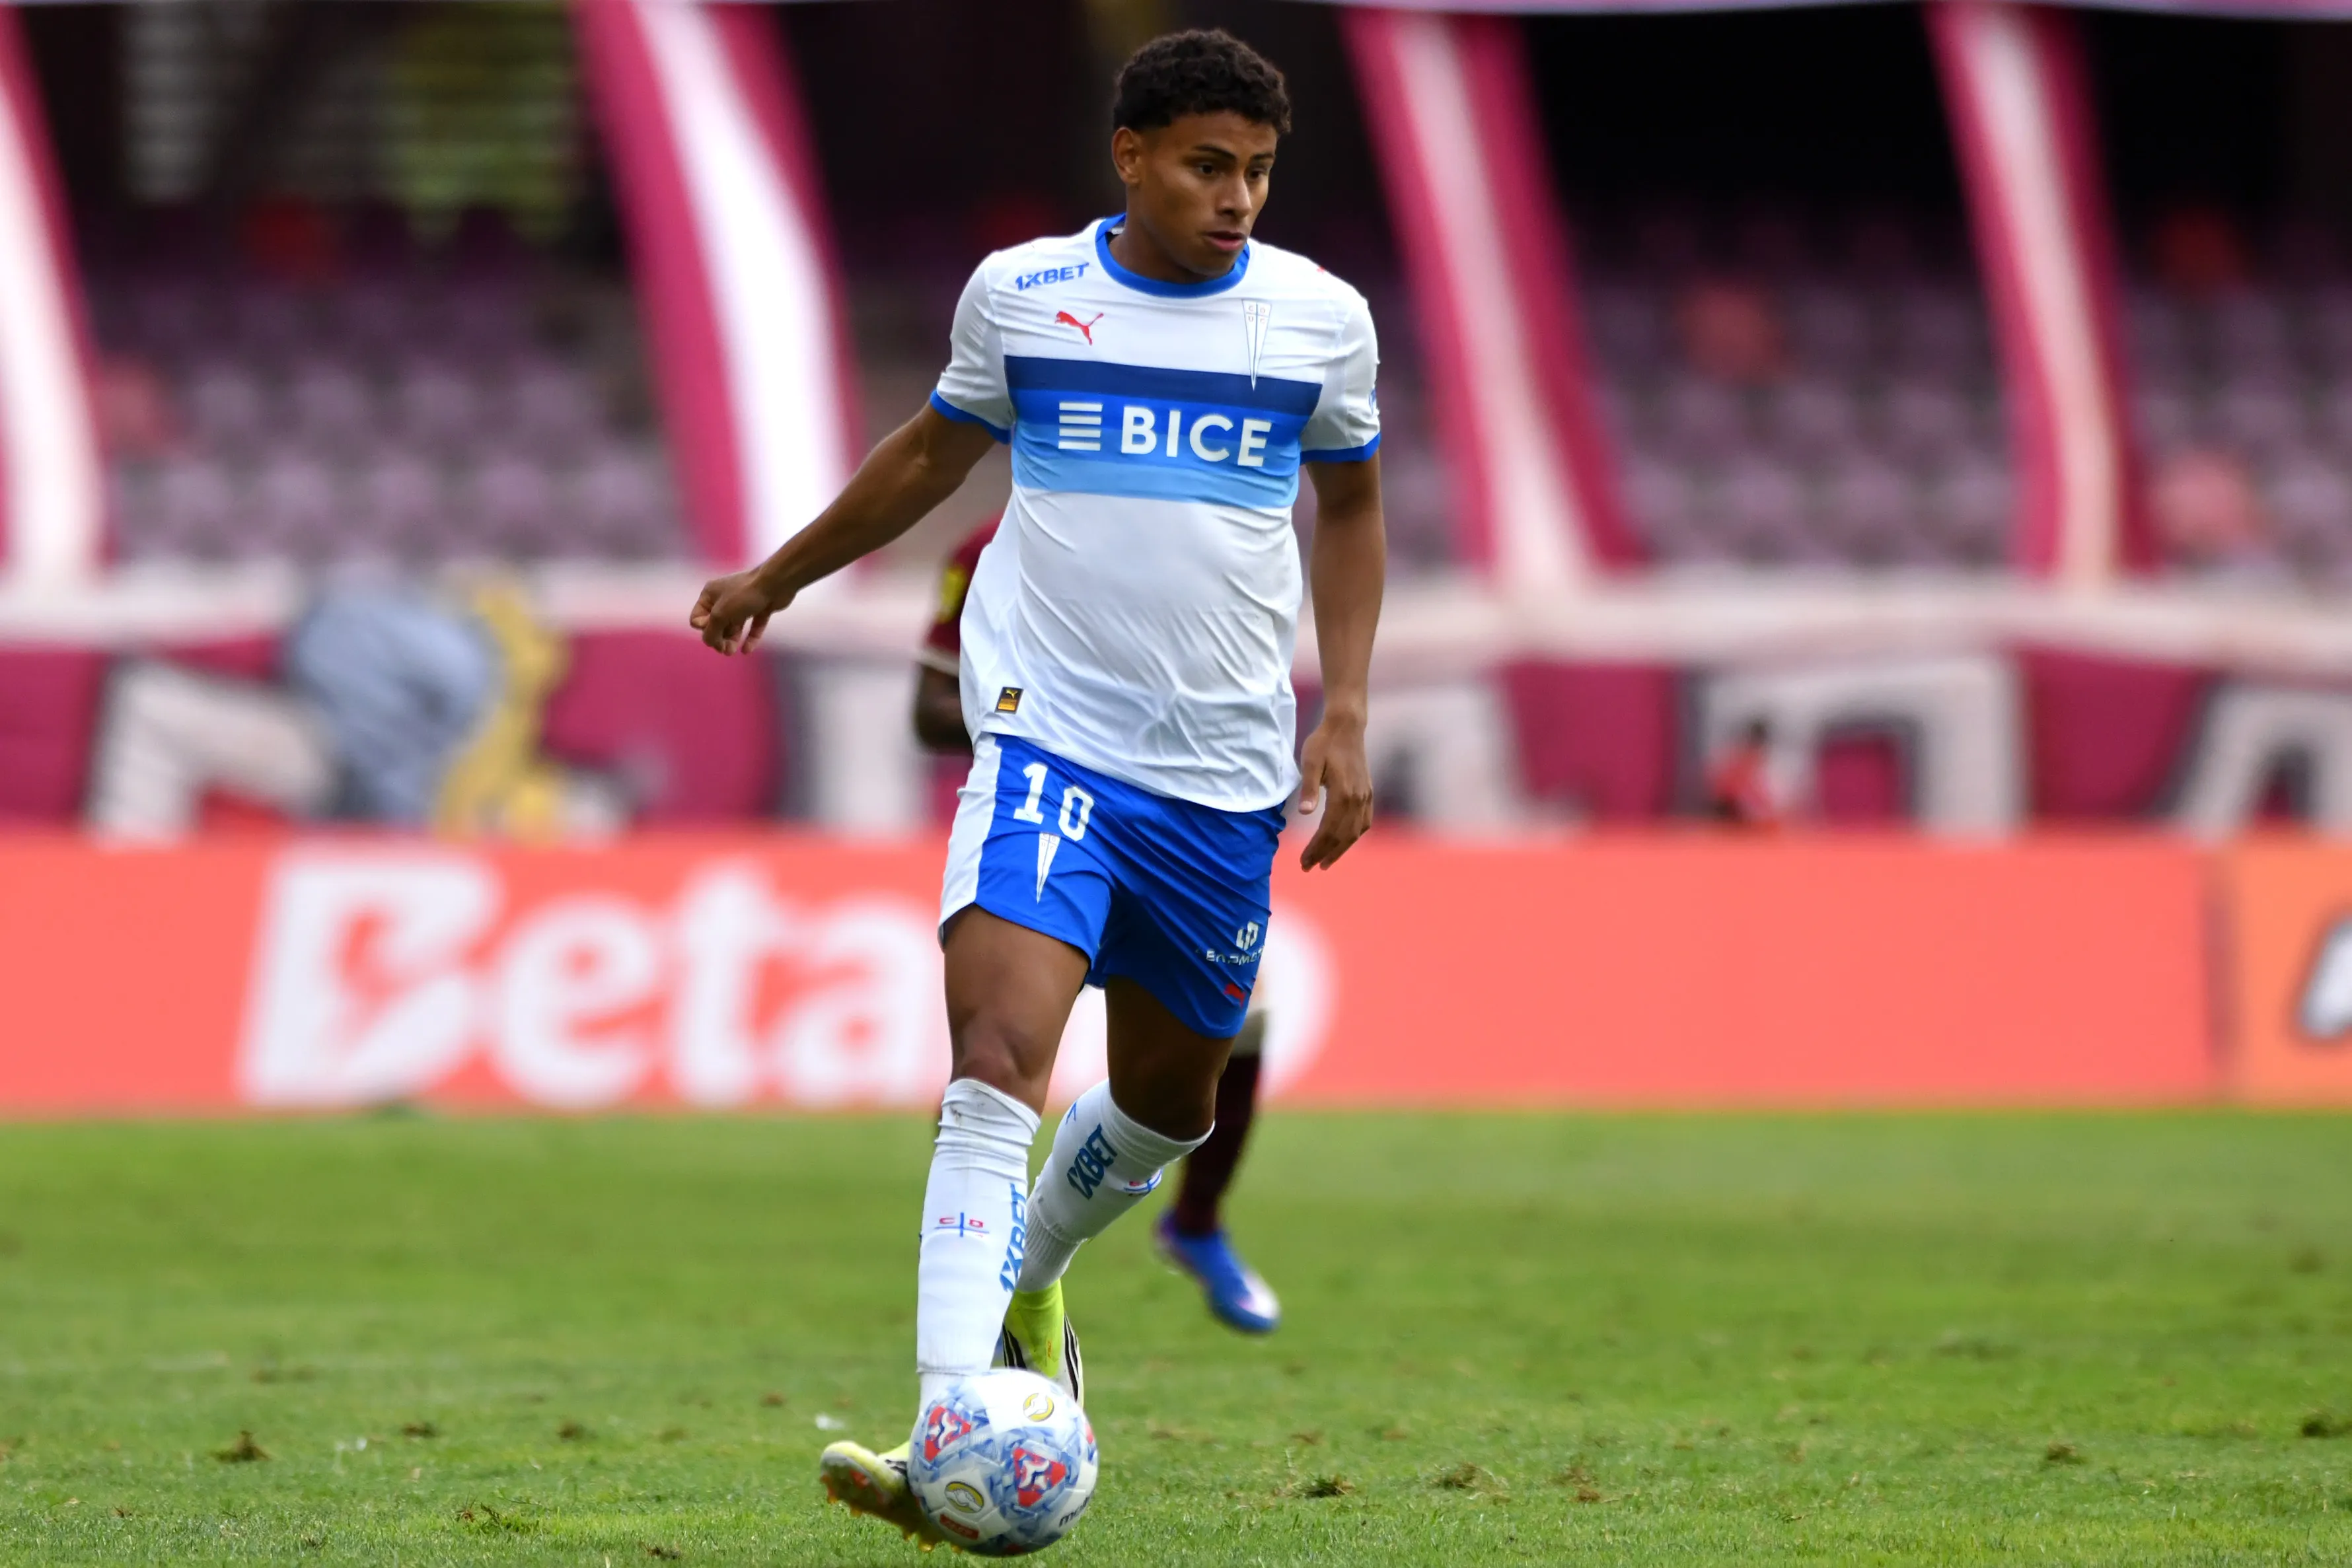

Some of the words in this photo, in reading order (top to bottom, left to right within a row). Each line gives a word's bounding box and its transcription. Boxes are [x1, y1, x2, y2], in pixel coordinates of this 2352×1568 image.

[1015, 262, 1089, 291] 1XBET
[1121, 406, 1272, 467] BICE
[1013, 762, 1095, 841] 10
[1066, 1123, 1118, 1200] 1XBET
